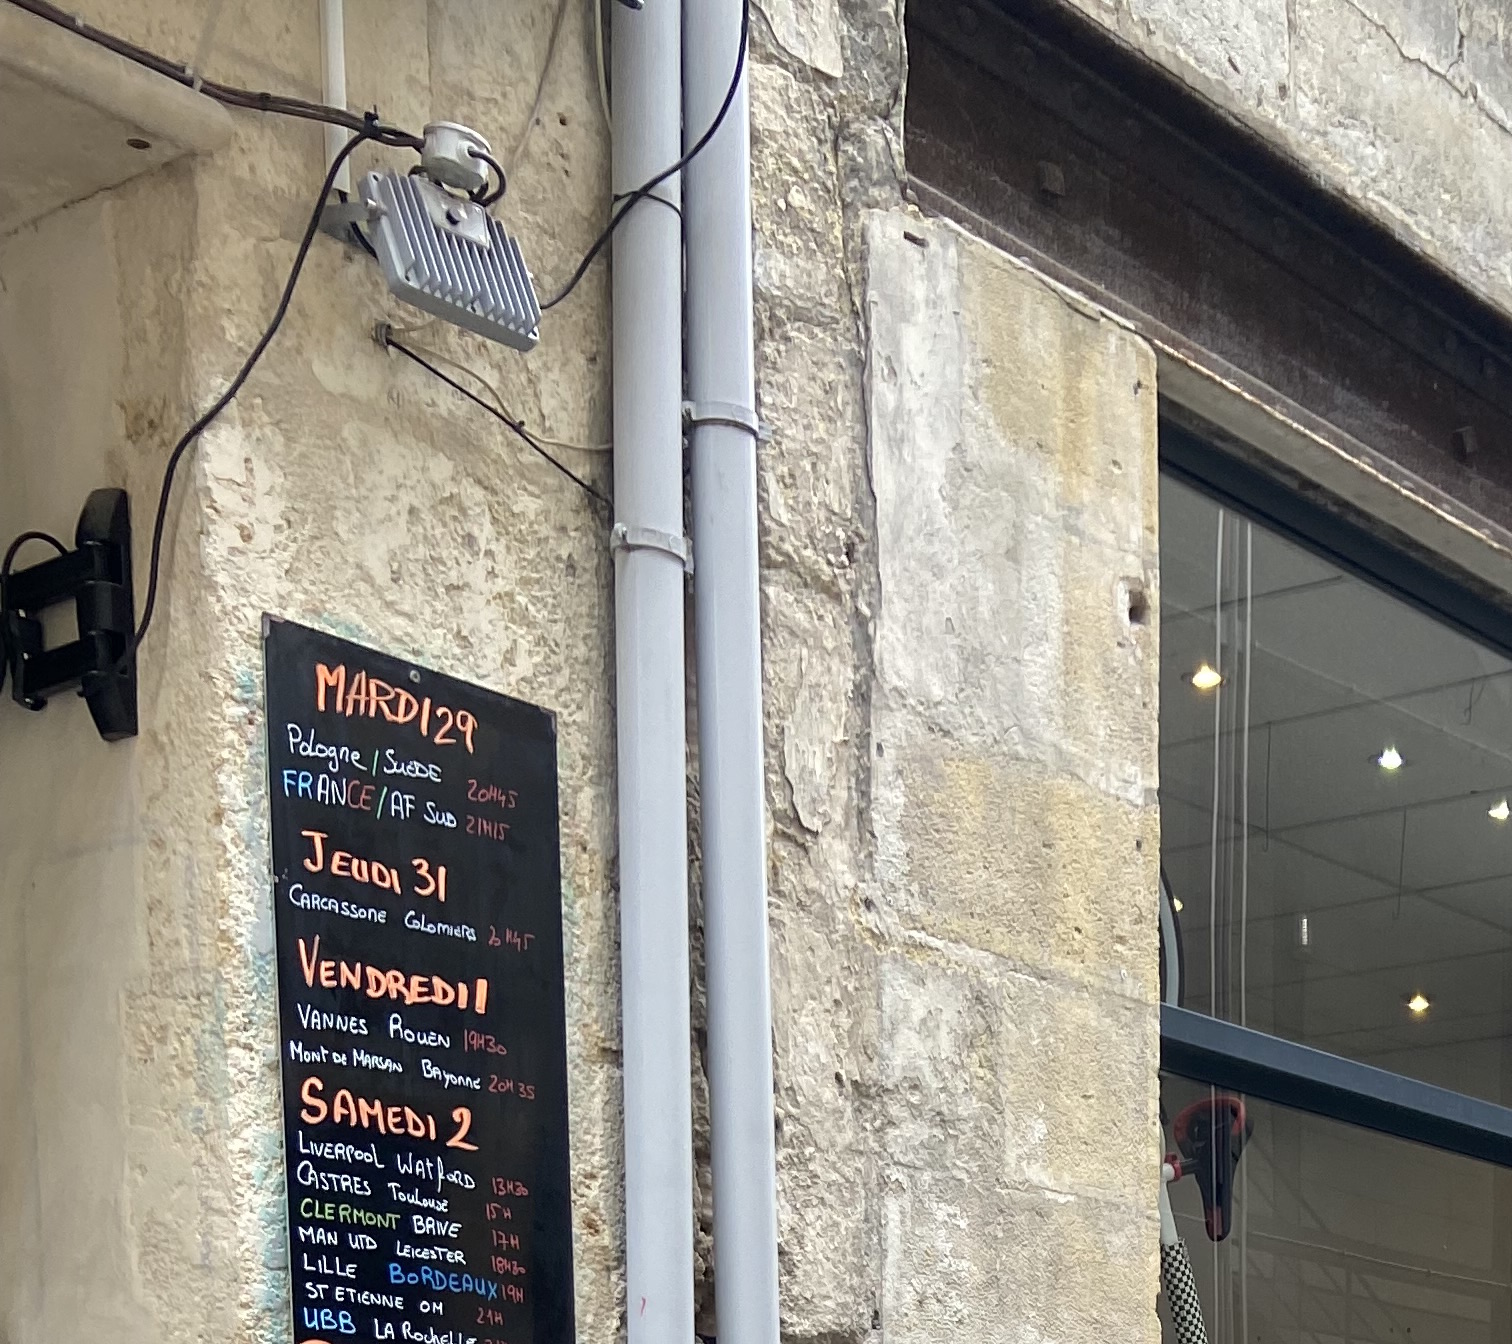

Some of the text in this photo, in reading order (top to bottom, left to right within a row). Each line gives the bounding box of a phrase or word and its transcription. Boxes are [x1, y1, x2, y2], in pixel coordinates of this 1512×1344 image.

[315, 662, 479, 754] MARDI 29
[301, 830, 448, 903] JEUDI 31
[298, 934, 469, 1010] VENDREDI
[297, 1003, 370, 1037] VANNES
[300, 1076, 480, 1151] SAMEDI 2
[297, 1160, 373, 1197] CASTRES
[300, 1198, 402, 1230] CLERMONT
[298, 1226, 339, 1248] MAN
[305, 1282, 329, 1300] ST
[335, 1286, 405, 1311] ETIENNE
[419, 1300, 444, 1316] OM
[303, 1307, 357, 1335] UBB
[374, 1318, 395, 1340] LA
